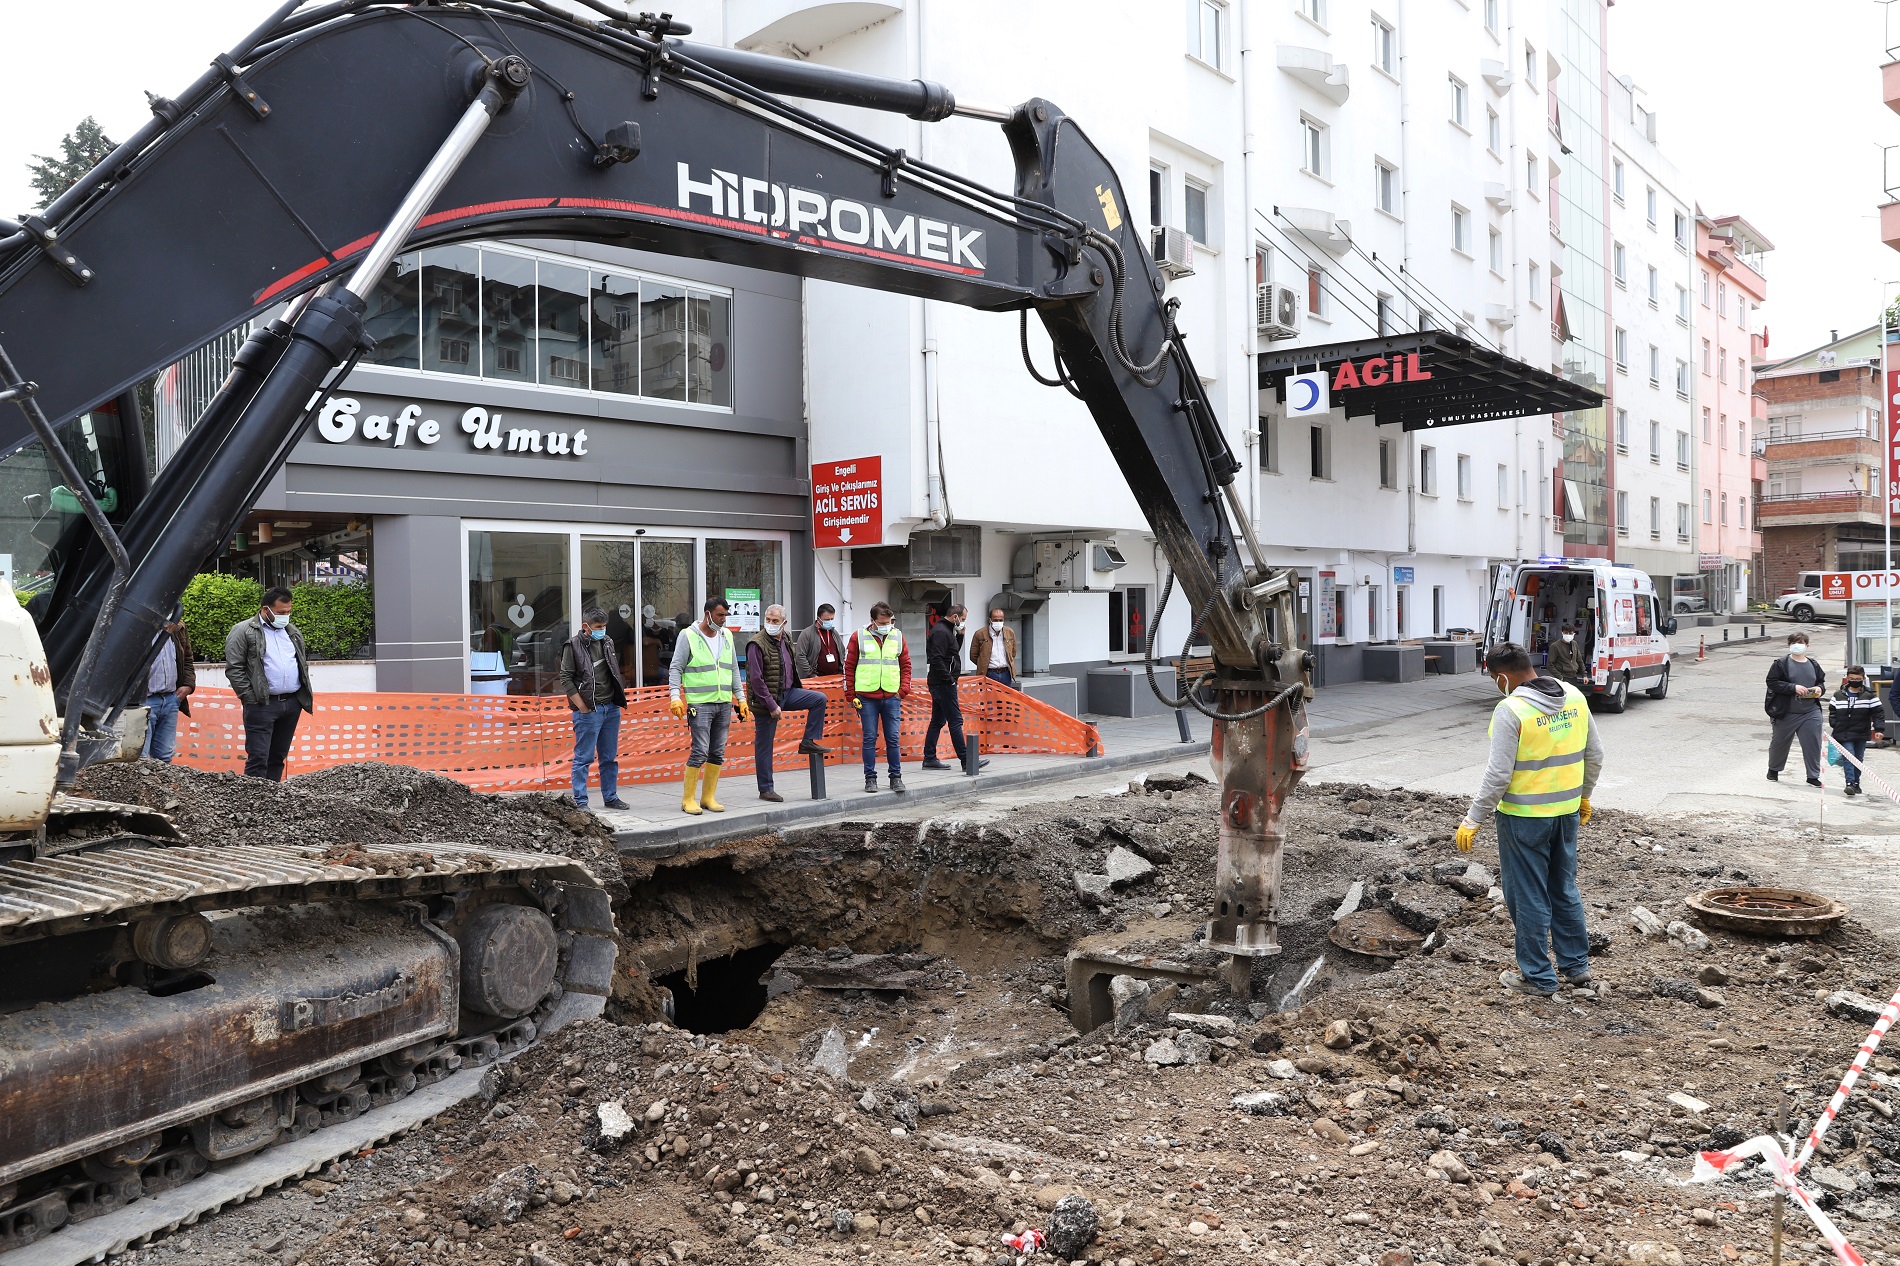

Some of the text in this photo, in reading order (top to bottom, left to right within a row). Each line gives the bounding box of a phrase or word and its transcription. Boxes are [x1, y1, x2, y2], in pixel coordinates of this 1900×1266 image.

[305, 391, 588, 456] Cafe Umut
[1441, 414, 1466, 422] UMUT
[835, 464, 857, 476] Engelli
[815, 483, 830, 495] Giriş
[831, 482, 840, 492] Ve
[815, 490, 878, 514] ACİL SERVİS
[823, 514, 870, 528] Girişindendir
